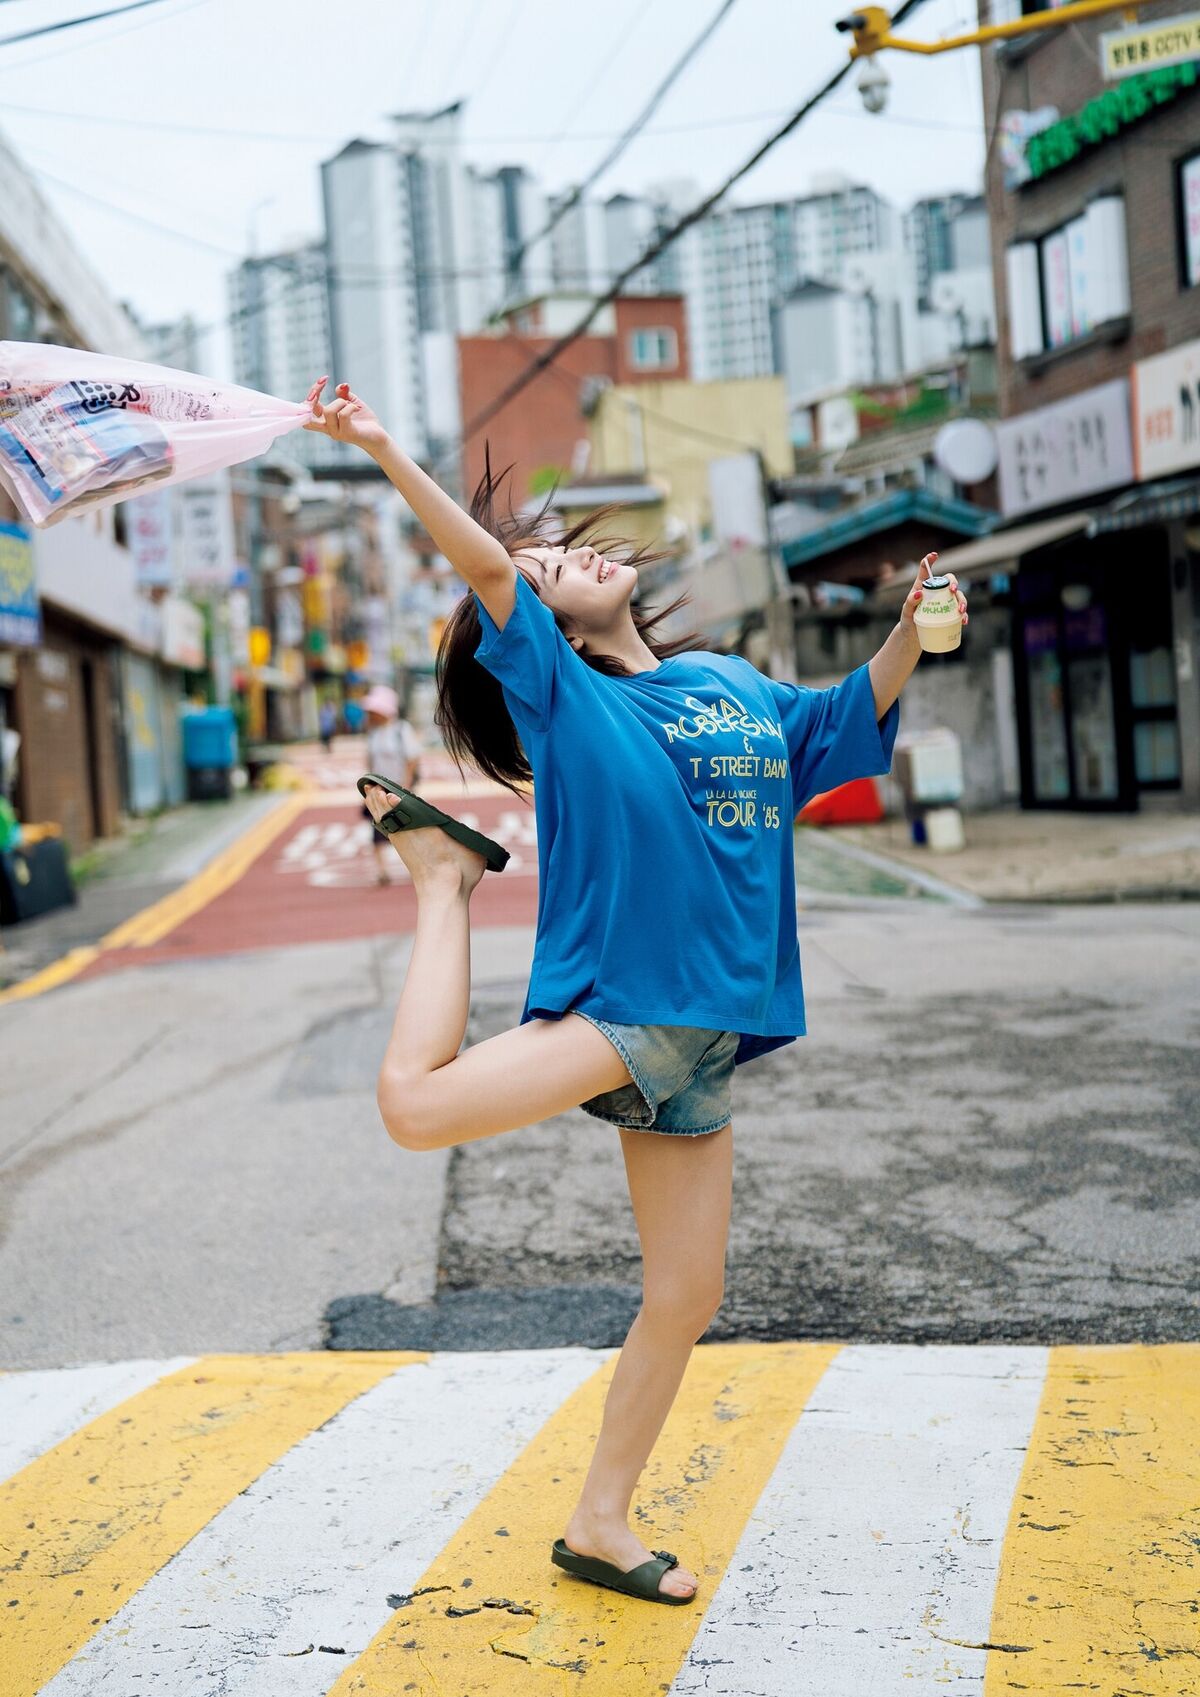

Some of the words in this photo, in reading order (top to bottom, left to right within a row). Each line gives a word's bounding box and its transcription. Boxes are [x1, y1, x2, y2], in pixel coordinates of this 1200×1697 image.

[1155, 30, 1192, 55] CCTV
[743, 736, 754, 754] &
[710, 755, 761, 778] STREET
[763, 757, 787, 779] BAND
[705, 789, 714, 799] LA
[716, 789, 726, 799] LA
[728, 789, 738, 799] LA
[706, 801, 756, 827] TOUR
